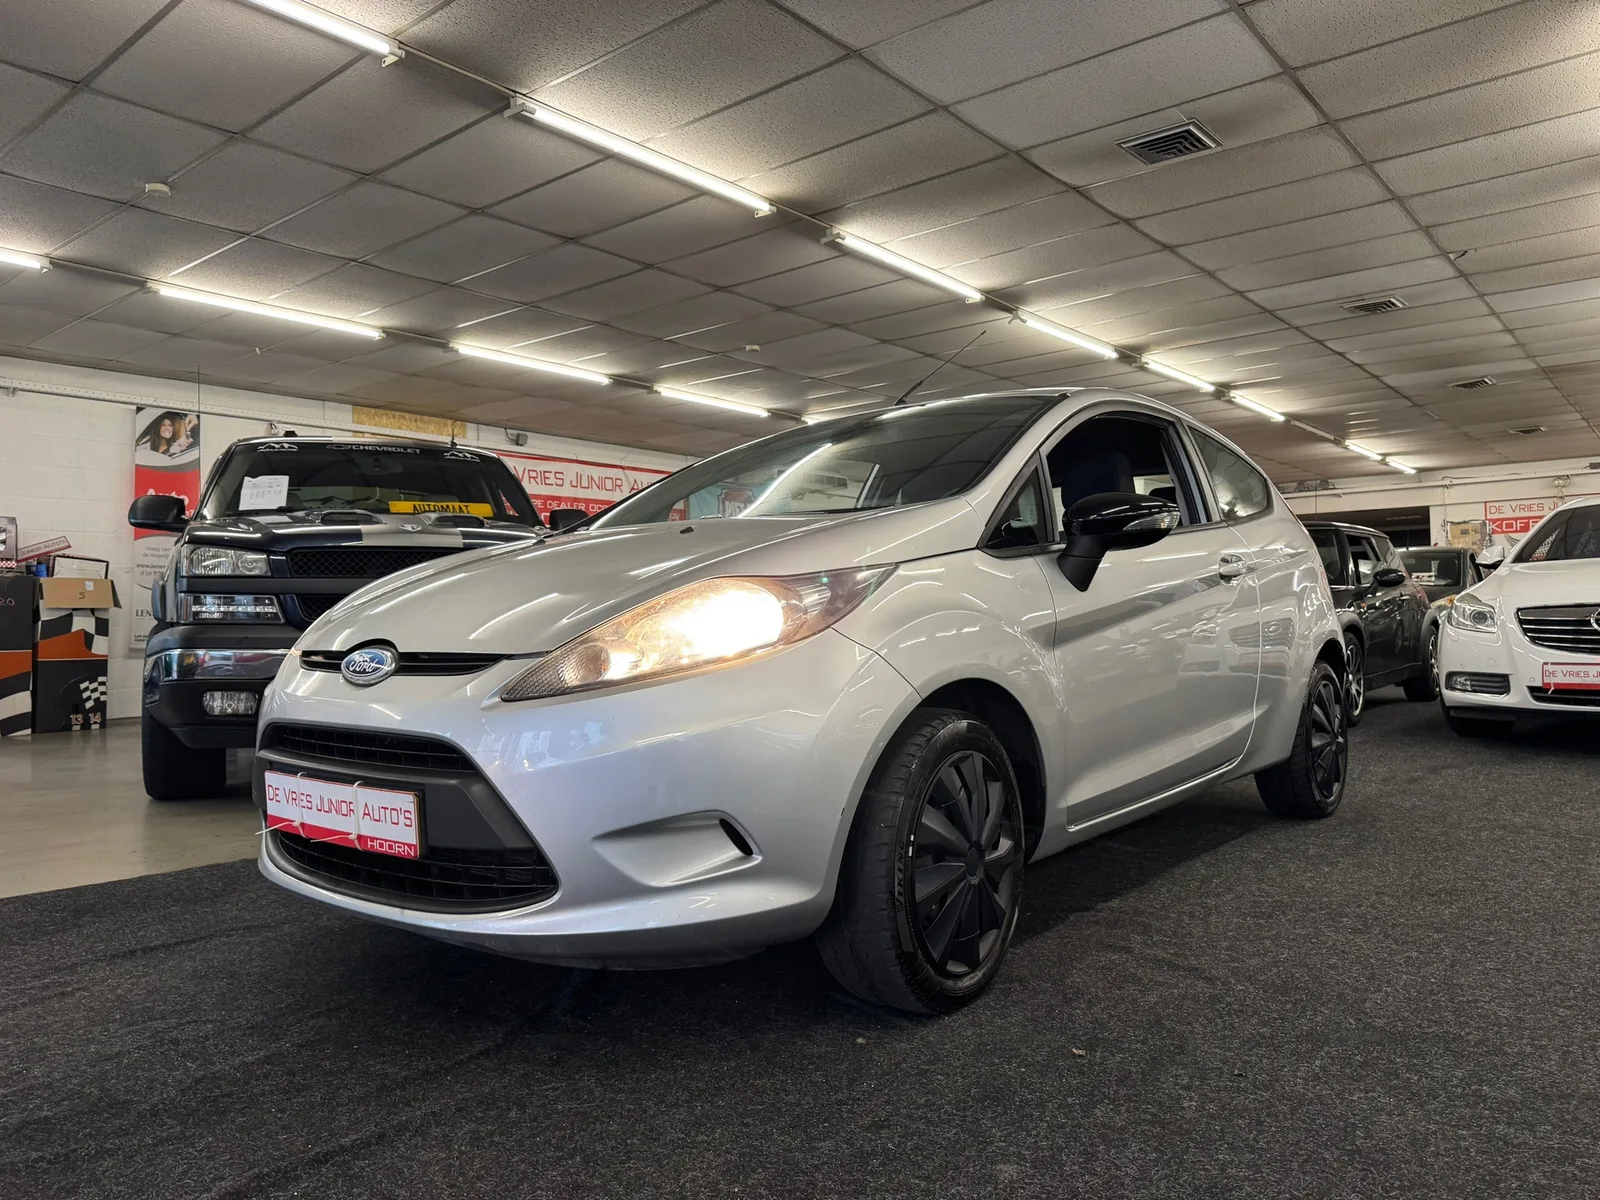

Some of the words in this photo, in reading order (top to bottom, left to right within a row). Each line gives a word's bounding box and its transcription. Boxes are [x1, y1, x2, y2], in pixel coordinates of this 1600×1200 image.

[351, 444, 421, 454] CHEVROLET
[513, 466, 564, 488] VRIES
[570, 471, 624, 493] JUNIOR
[412, 503, 471, 514] AUTOMAAT
[547, 500, 586, 511] DEALER
[1489, 505, 1504, 515] DE
[1510, 502, 1544, 513] VRIES
[349, 656, 379, 672] Ford
[1544, 669, 1558, 678] DE
[1561, 669, 1590, 678] VRIES
[267, 784, 281, 803] DE
[315, 794, 355, 818] JUNIOR
[362, 802, 413, 828] AUTO'S
[367, 838, 415, 857] HOORN
